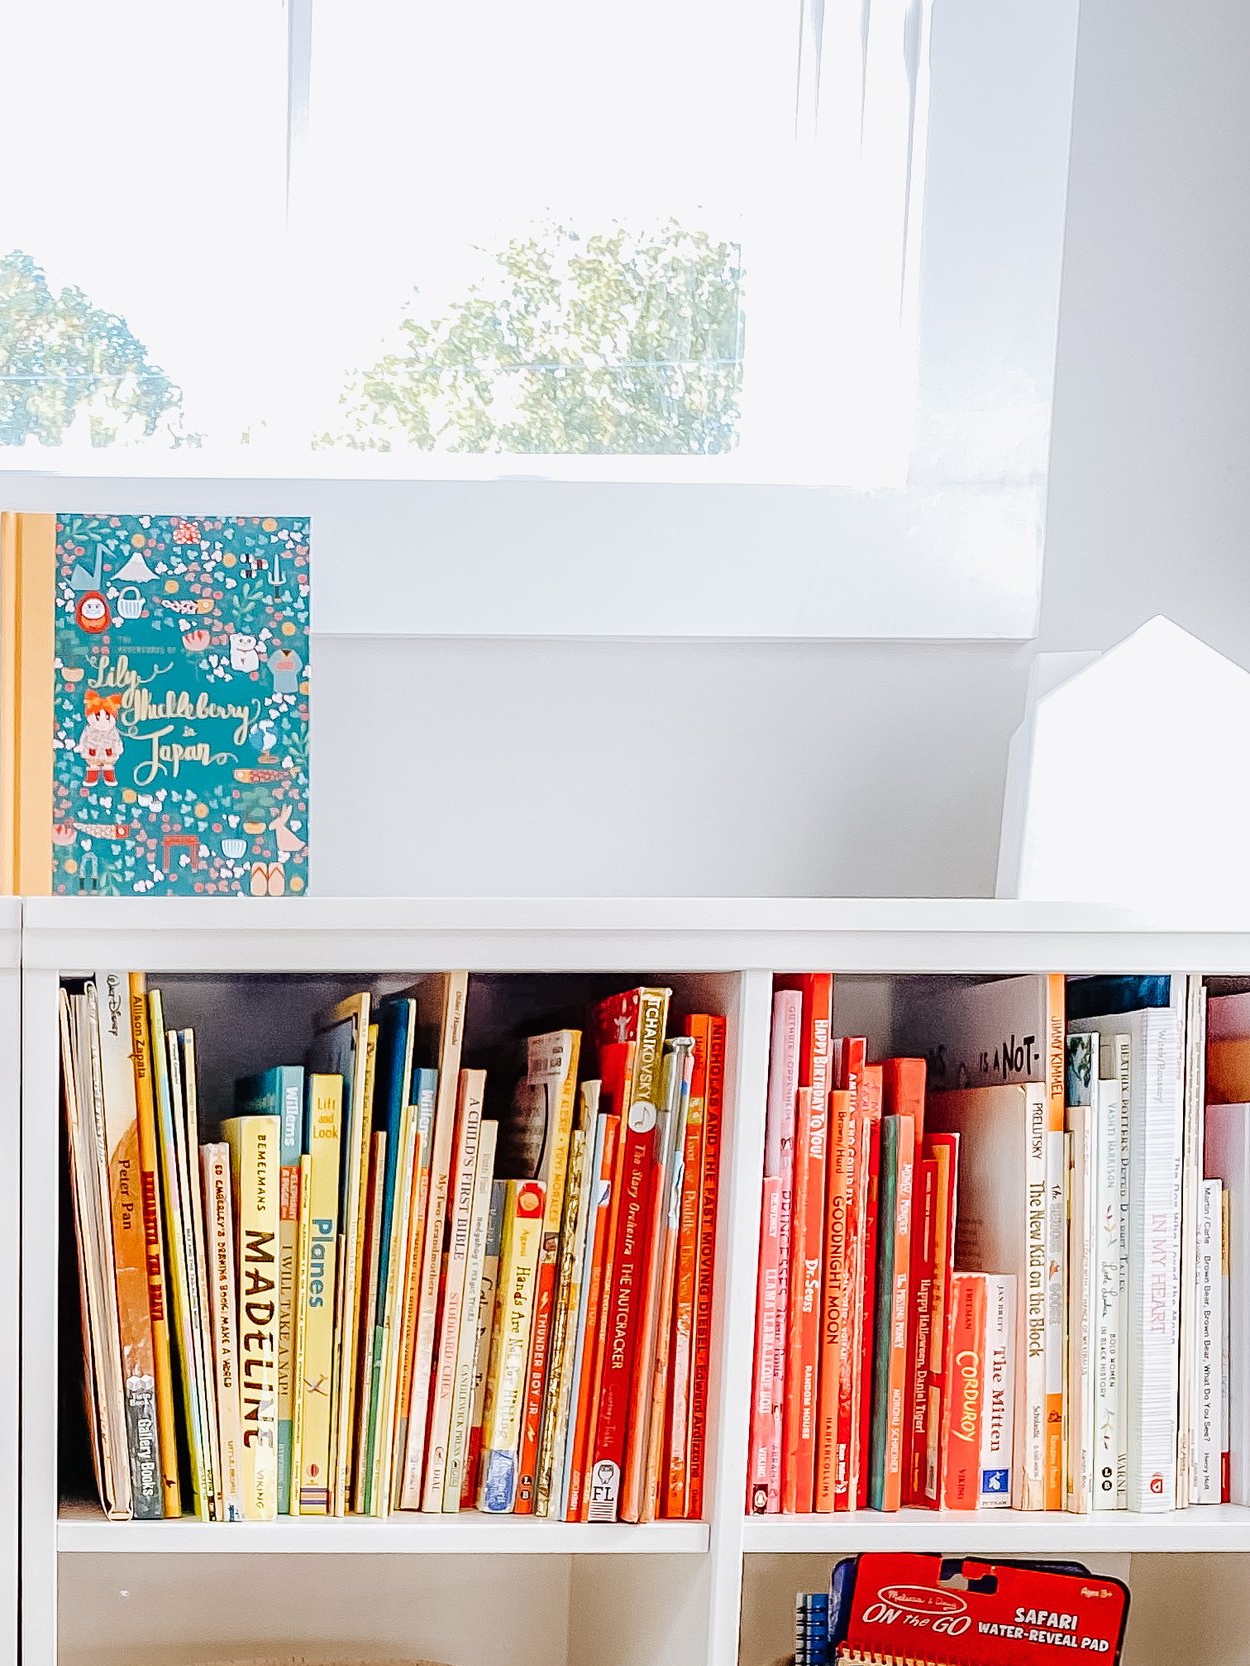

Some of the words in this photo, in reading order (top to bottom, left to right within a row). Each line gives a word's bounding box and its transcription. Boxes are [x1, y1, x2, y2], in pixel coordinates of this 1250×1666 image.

[86, 655, 167, 708] Lily
[121, 688, 261, 746] Huckleberry
[130, 725, 238, 786] Japan
[133, 995, 144, 1036] Allison
[1051, 1015, 1063, 1050] JIMMY
[638, 1000, 661, 1100] TCHAIKOVSKY
[812, 1019, 829, 1055] HAPPY
[129, 1040, 146, 1079] Zapata
[707, 1024, 724, 1110] NICHOLAS
[1051, 1053, 1063, 1100] KIMMEL
[470, 1097, 481, 1107] A
[811, 1055, 828, 1110] BIRTHDAY
[284, 1086, 298, 1147] Willems
[707, 1114, 719, 1146] AND
[810, 1113, 825, 1129] TO
[1031, 1103, 1044, 1160] PRELUTSKY
[464, 1111, 480, 1167] CHILD'S
[809, 1129, 824, 1159] YOU!
[835, 1111, 847, 1174] Brown/Hurd
[118, 1159, 133, 1196] Peter
[256, 1134, 266, 1212] BEMELMANS
[438, 1174, 448, 1191] My
[704, 1151, 716, 1182] THE
[435, 1195, 446, 1216] Two
[458, 1172, 473, 1213] FIRST
[702, 1187, 714, 1225] FAST
[1030, 1180, 1045, 1206] The
[122, 1203, 134, 1230] Pan
[1030, 1210, 1045, 1239] New
[1152, 1213, 1166, 1232] IN
[428, 1219, 444, 1296] Grandmothers
[453, 1217, 468, 1261] BIBLE
[828, 1195, 844, 1289] GOODNIGHT
[1030, 1243, 1044, 1268] Kid
[1152, 1239, 1166, 1265] MY
[280, 1256, 292, 1295] WILL
[309, 1219, 333, 1308] Planes
[619, 1263, 634, 1285] THE
[698, 1231, 712, 1296] MOVING
[804, 1258, 819, 1278] Dr.
[1030, 1270, 1041, 1289] on
[802, 1279, 818, 1312] Seuss
[1030, 1292, 1044, 1314] the
[1151, 1273, 1166, 1335] HEART
[279, 1299, 291, 1340] TAKE
[611, 1289, 631, 1369] NUTCRACKER
[696, 1301, 710, 1354] DIESEL
[826, 1296, 840, 1345] MOON
[1029, 1318, 1044, 1358] Block
[243, 1230, 275, 1449] MADELINE
[278, 1345, 290, 1355] A
[277, 1359, 290, 1395] NAP!
[993, 1346, 1007, 1383] The
[803, 1365, 813, 1405] RANDOM
[951, 1350, 979, 1442] CORDUROY
[136, 1418, 152, 1458] Gallery
[801, 1408, 811, 1439] HOUSE
[990, 1389, 1005, 1452] Mitten
[757, 1446, 767, 1477] VIKING
[821, 1417, 833, 1497] HARPERCOLLINS
[140, 1462, 155, 1496] Books
[255, 1469, 265, 1510] VIKING
[957, 1468, 967, 1499] VIKING
[862, 1603, 902, 1625] ON
[904, 1613, 930, 1627] the
[932, 1616, 971, 1637] GO
[978, 1621, 1078, 1648] WATER-REVEAL
[1081, 1637, 1109, 1653] PAD
[1014, 1607, 1078, 1631] SAFARI
